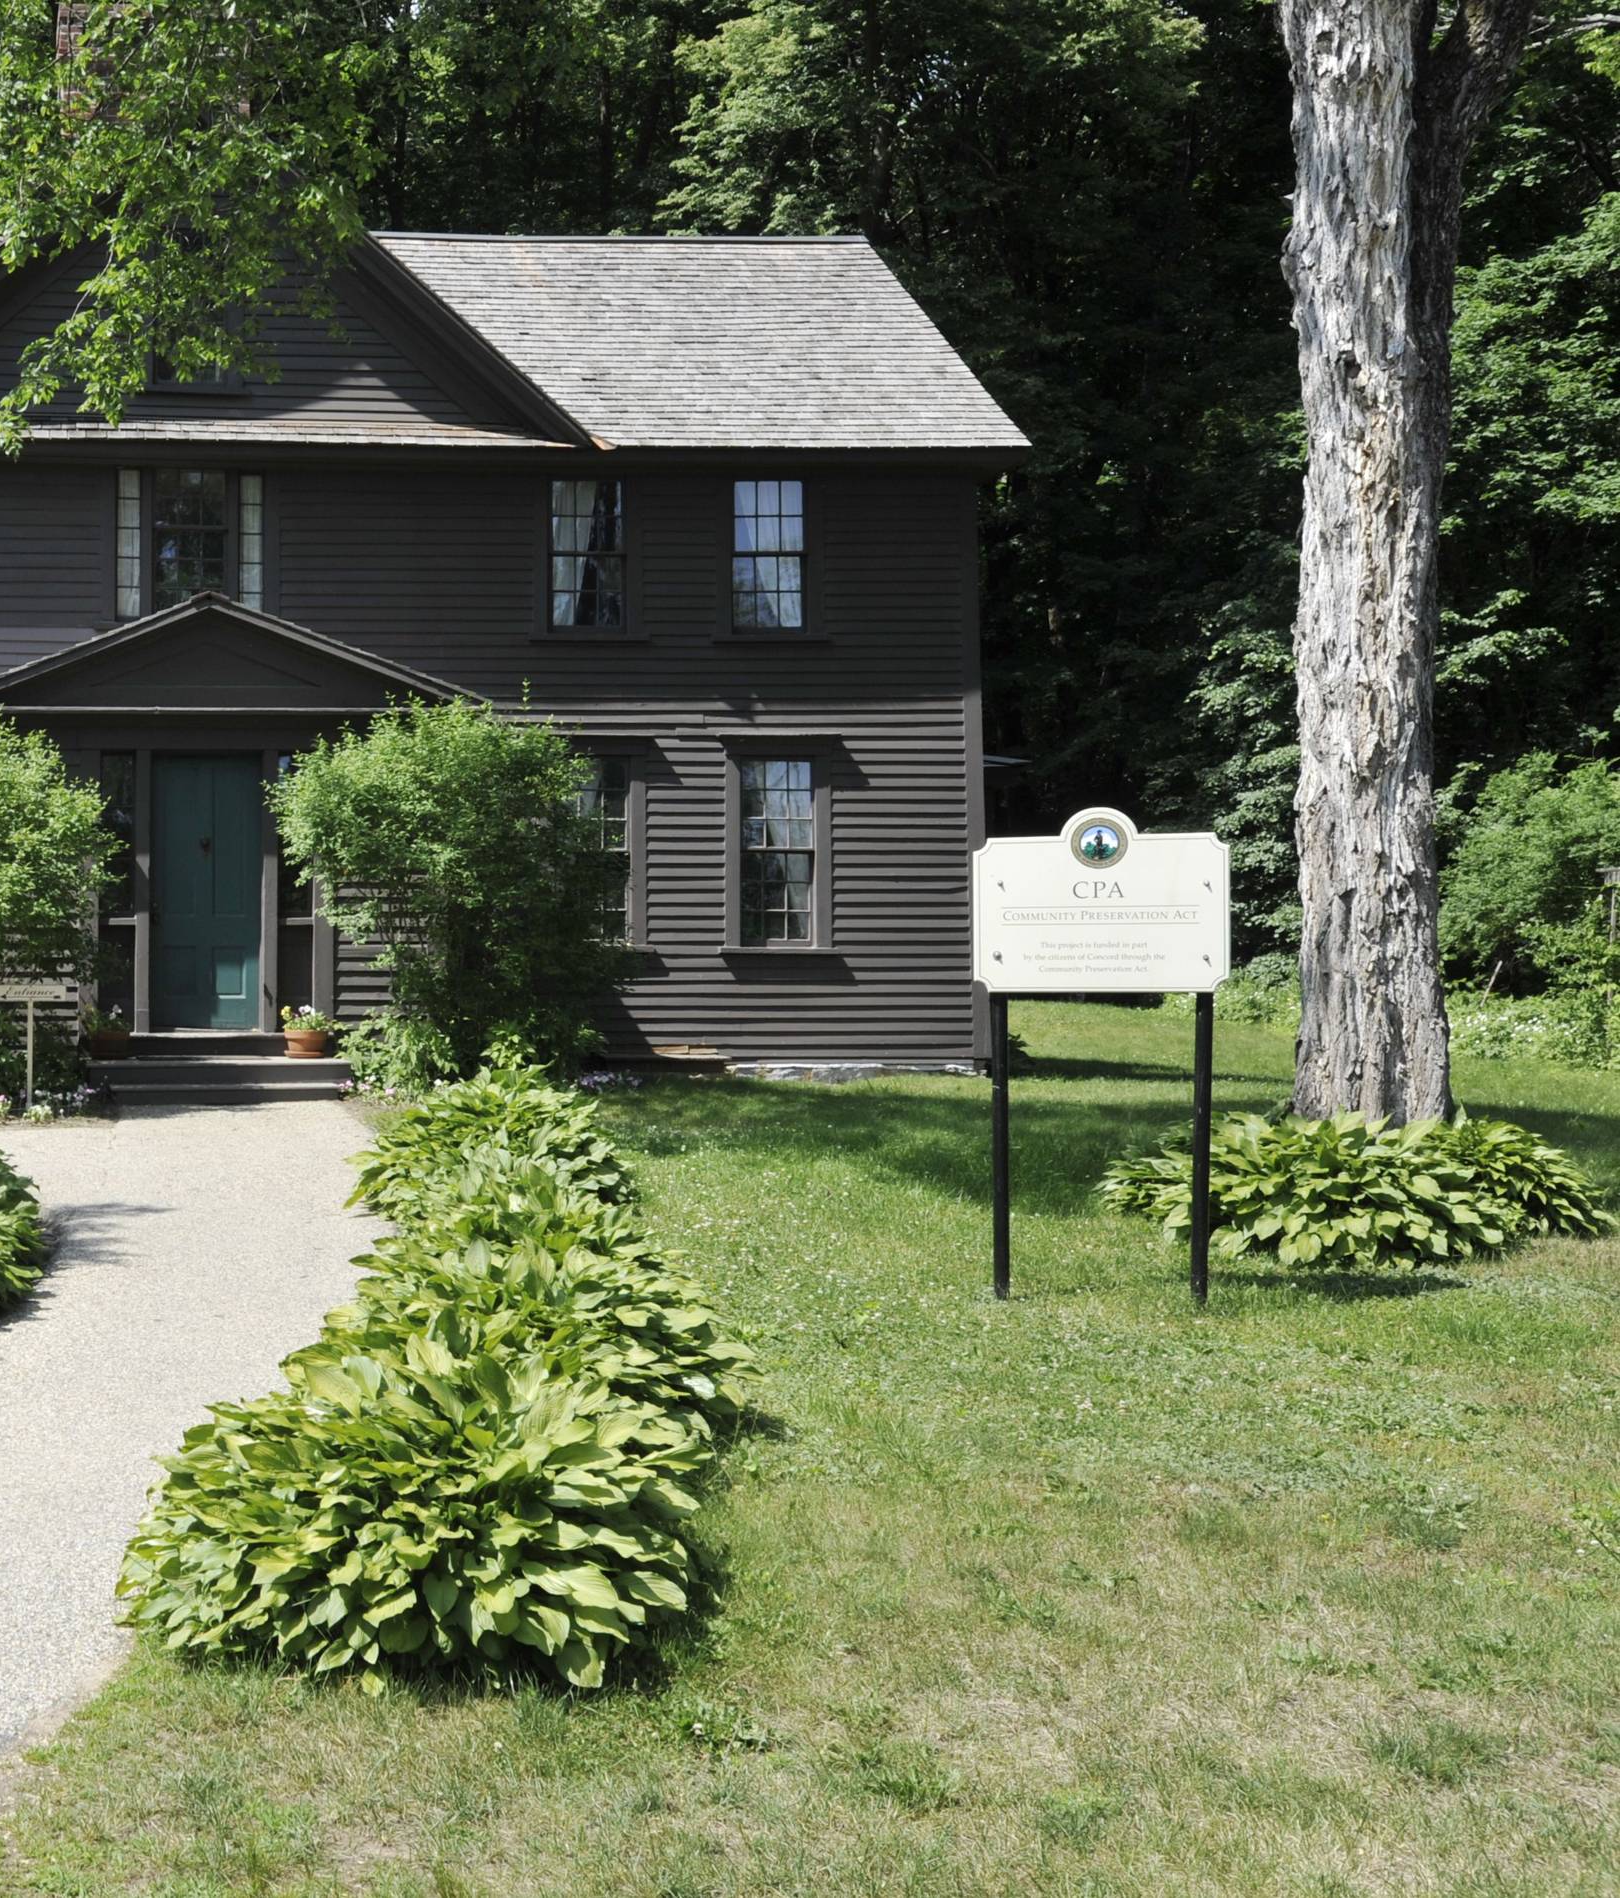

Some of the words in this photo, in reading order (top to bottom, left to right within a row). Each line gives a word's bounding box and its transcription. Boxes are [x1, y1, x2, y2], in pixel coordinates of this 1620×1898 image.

[1072, 880, 1125, 899] CPA
[1002, 909, 1076, 922] COMMUNITY
[1040, 941, 1056, 949] This
[1058, 942, 1083, 951] project
[1093, 941, 1120, 949] funded
[1122, 941, 1130, 949] in
[1131, 942, 1148, 951] part
[1023, 953, 1033, 963] by
[1035, 953, 1046, 961] the
[1047, 953, 1076, 961] citizens
[1077, 953, 1085, 961] of
[1086, 953, 1119, 961] Concord
[1121, 953, 1151, 963] through
[1153, 953, 1166, 961] the
[1038, 965, 1083, 974] Community
[1084, 965, 1132, 973] Preservation
